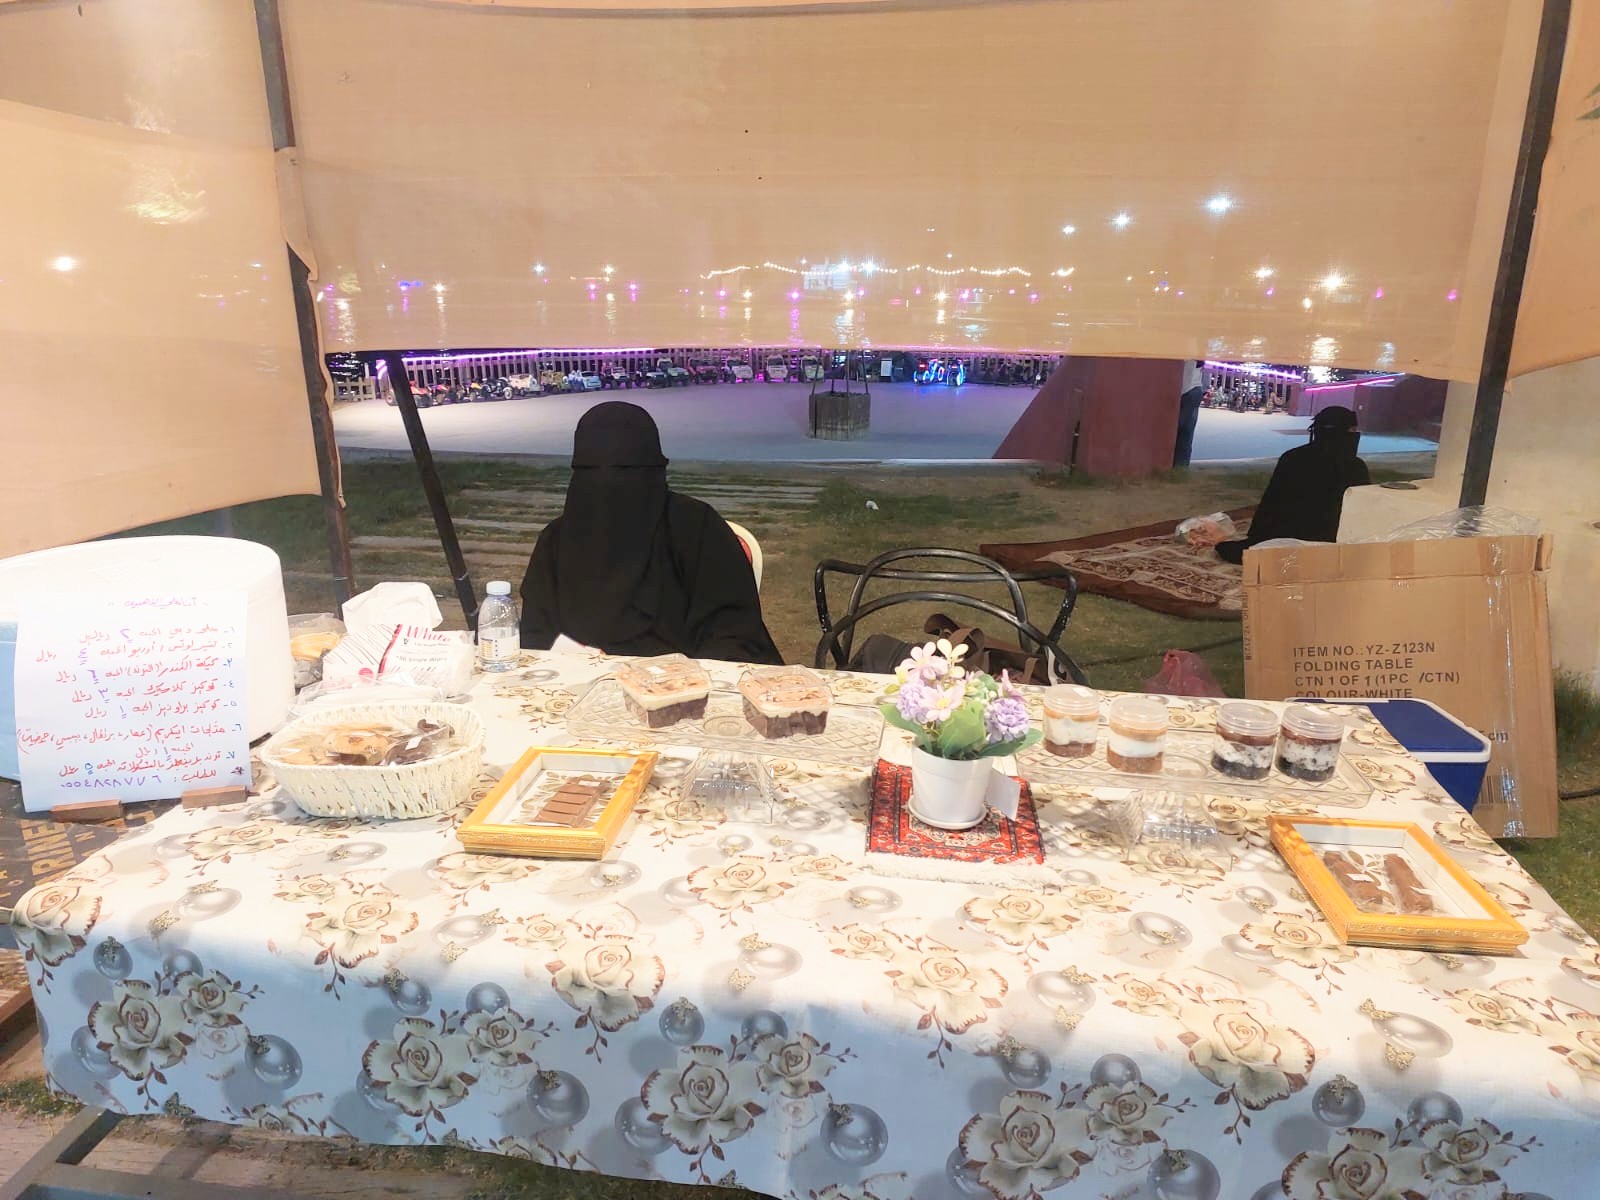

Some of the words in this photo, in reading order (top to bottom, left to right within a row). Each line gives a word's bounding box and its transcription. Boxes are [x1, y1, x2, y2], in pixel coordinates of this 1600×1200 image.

[1293, 646, 1328, 657] ITEM
[1294, 661, 1360, 672] FOLDING
[1365, 658, 1413, 670] TABLE
[1295, 676, 1324, 687] CTN
[1328, 677, 1334, 685] 1
[1339, 675, 1360, 685] OF
[1365, 676, 1371, 686] 1
[1418, 671, 1461, 684] /CTN)
